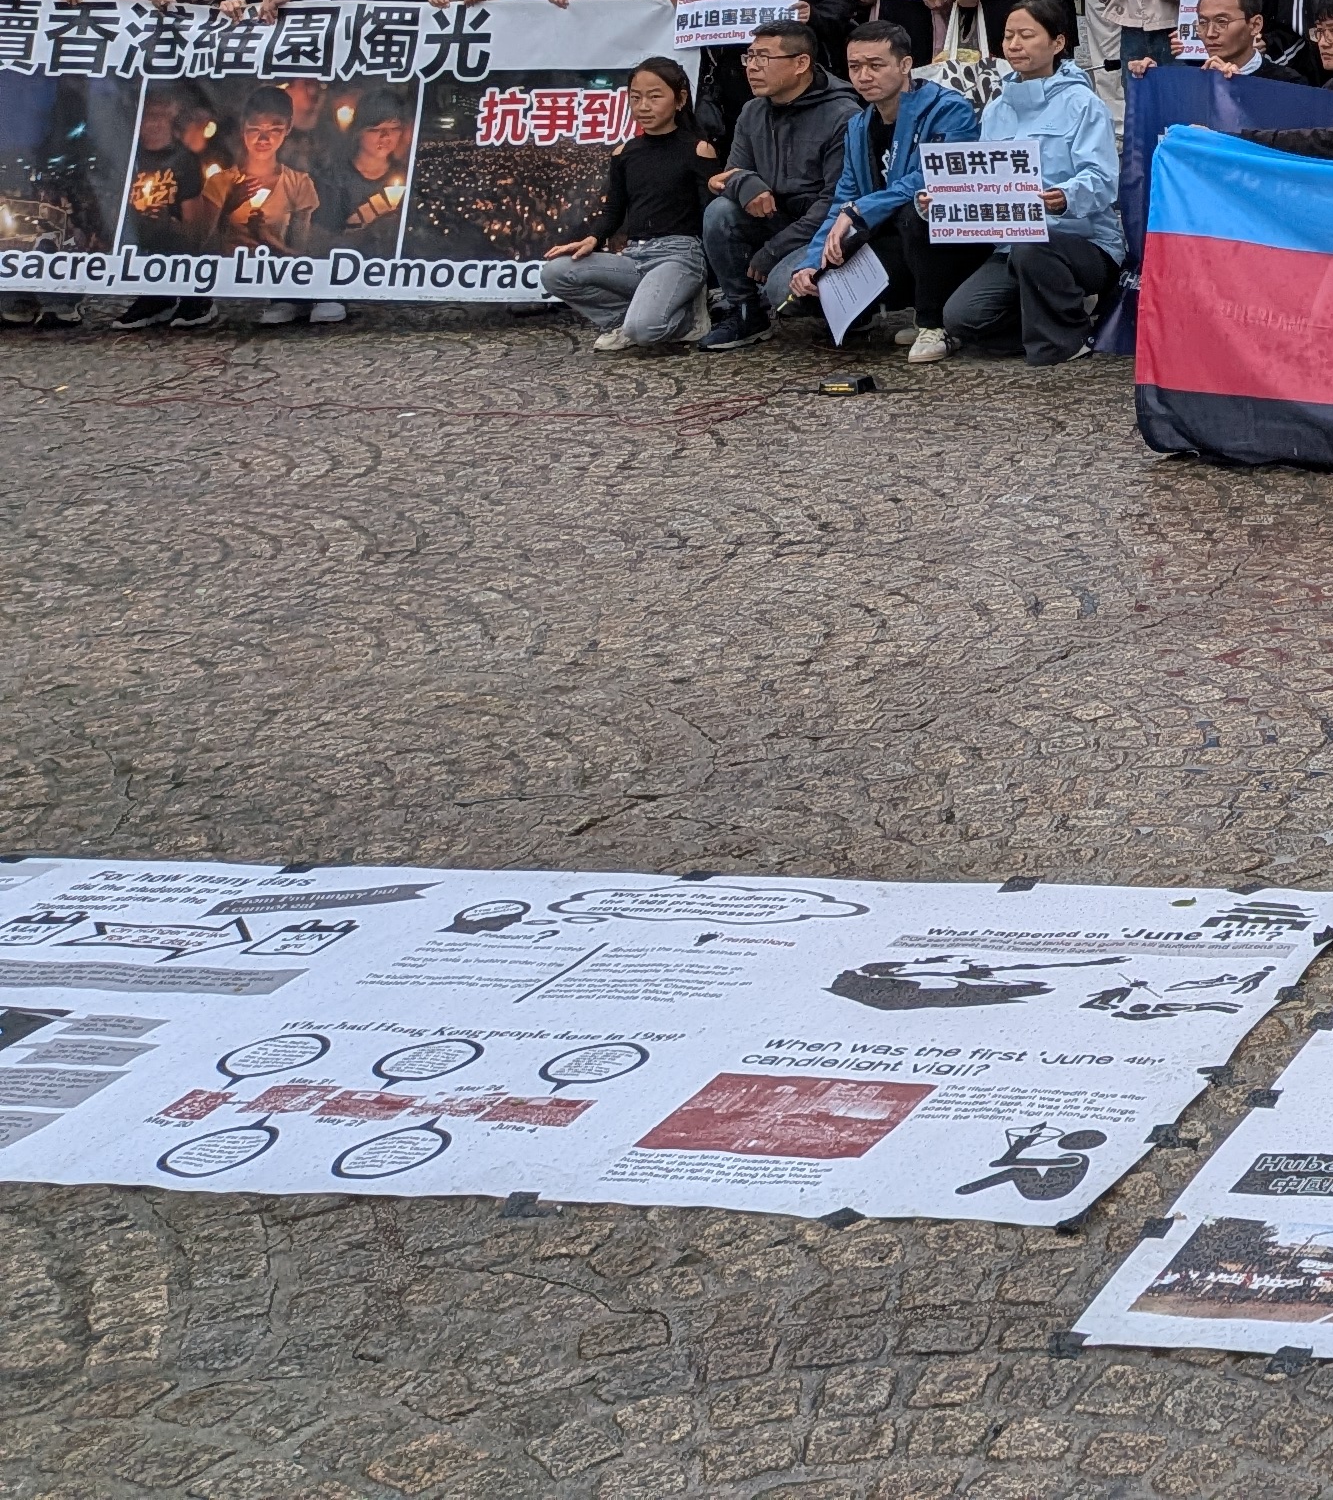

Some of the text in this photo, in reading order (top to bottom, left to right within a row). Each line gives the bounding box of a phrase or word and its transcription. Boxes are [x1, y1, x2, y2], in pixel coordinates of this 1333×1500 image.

[675, 29, 746, 44] STOP Persecuting
[927, 183, 975, 193] Communist
[977, 183, 1000, 194] Party
[1004, 182, 1012, 192] of
[932, 227, 1046, 238] STOP Persecuting Christians
[235, 250, 314, 287] Live
[330, 255, 548, 291] Democrac
[765, 1039, 842, 1051] When
[851, 1044, 908, 1056] was
[915, 1047, 961, 1057] the
[969, 1049, 1027, 1061] first
[742, 1055, 990, 1076] candlelight vigil?
